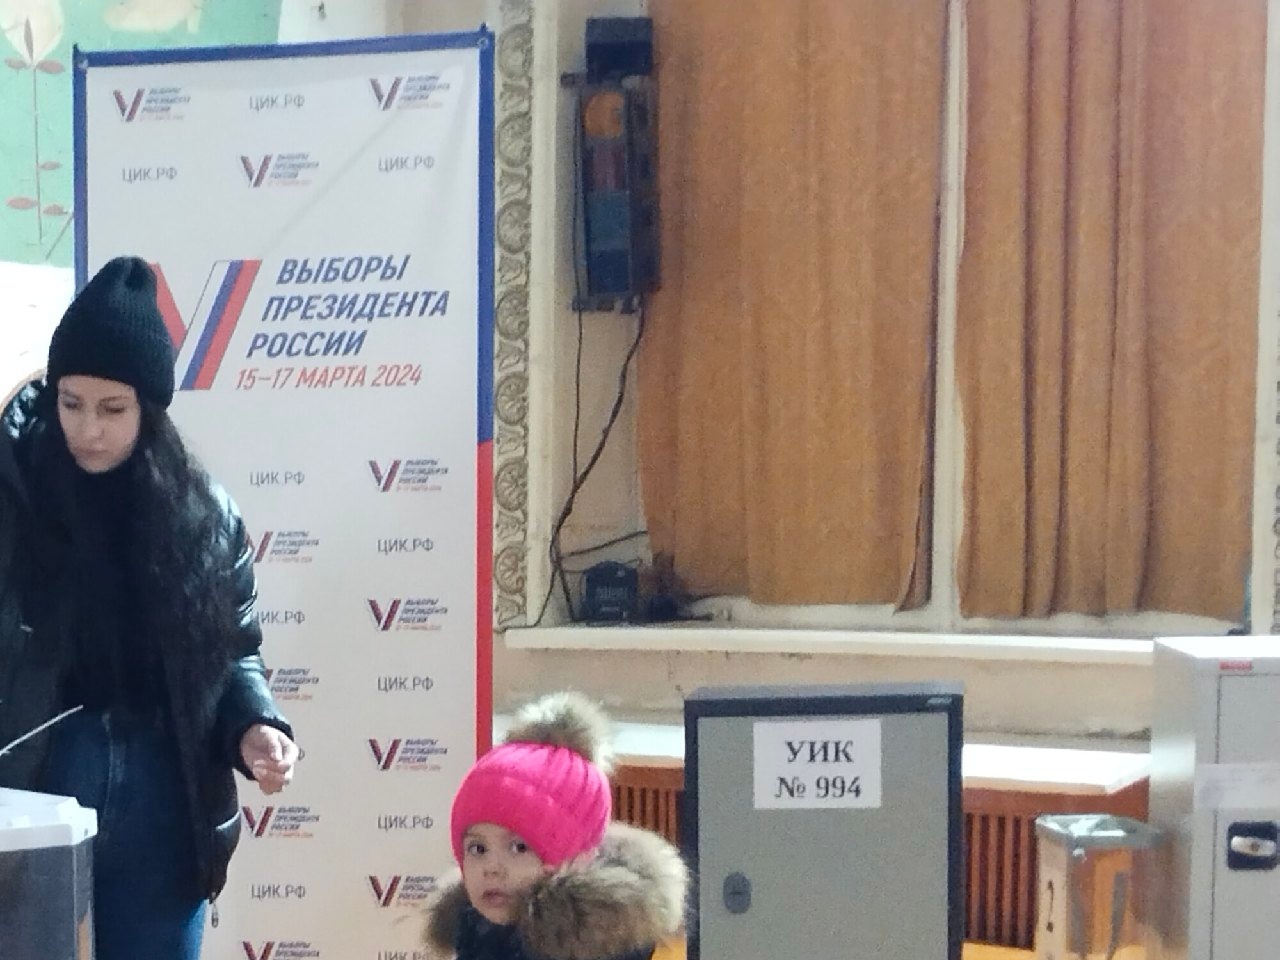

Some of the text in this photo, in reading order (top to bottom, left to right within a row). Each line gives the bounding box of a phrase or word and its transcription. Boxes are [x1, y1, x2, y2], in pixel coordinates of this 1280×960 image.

[249, 94, 305, 111] ЦИК.РФ
[378, 156, 435, 172] ЦИК.РФ
[122, 167, 177, 183] ЦИК.РФ
[276, 255, 411, 286] ВЫБОРЫ
[262, 290, 450, 322] ПРЕЗИДЕНТА
[246, 330, 367, 359] РОССИИ
[295, 365, 367, 388] МАРТА
[372, 364, 423, 387] 2024
[249, 471, 305, 486] ЦИК.РФ
[377, 537, 434, 555] ЦИК.РФ
[377, 676, 434, 693] ЦИК.РФ
[785, 740, 854, 763] УИК
[815, 776, 861, 798] 994
[377, 815, 434, 833] ЦИК.РФ
[251, 884, 306, 900] ЦИК.РФ
